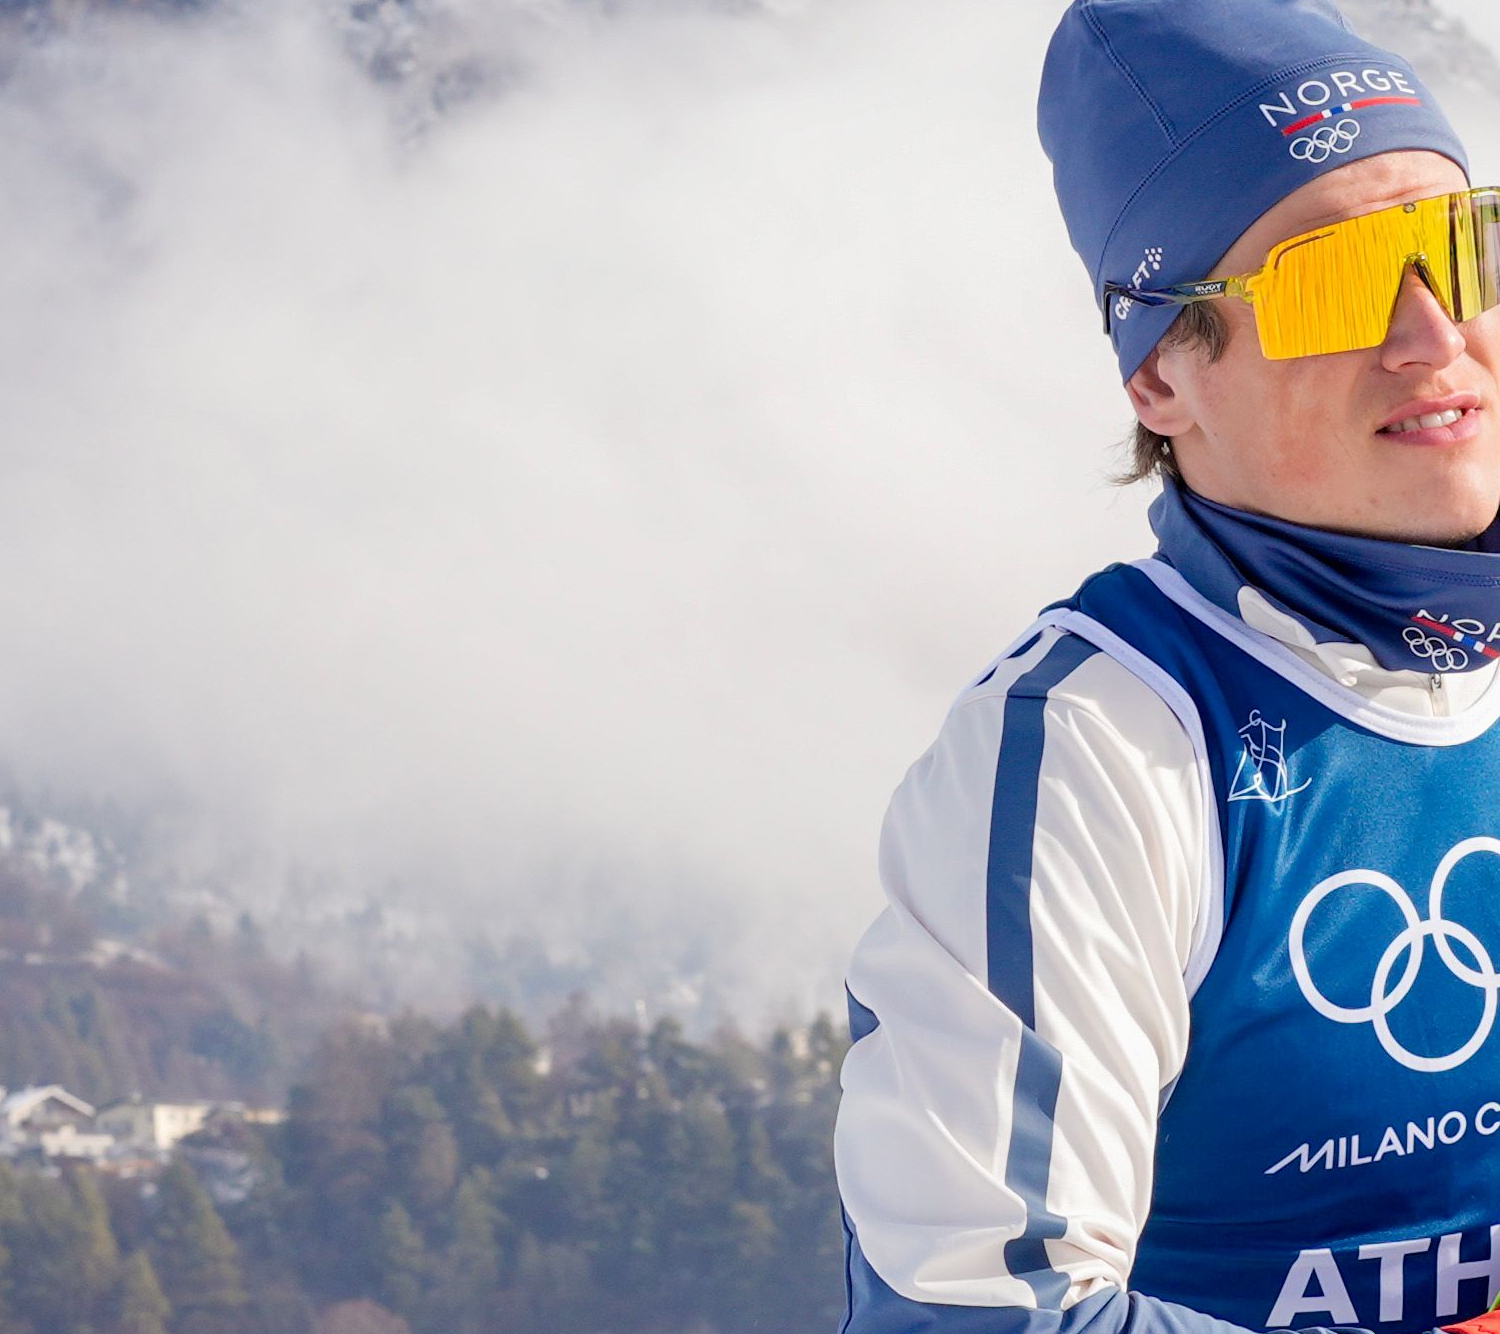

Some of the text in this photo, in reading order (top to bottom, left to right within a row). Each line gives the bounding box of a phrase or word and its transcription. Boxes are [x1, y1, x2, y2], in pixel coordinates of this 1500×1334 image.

[1259, 69, 1416, 127] NORGE
[1114, 260, 1151, 321] CRFT
[1263, 1111, 1468, 1175] MILANO
